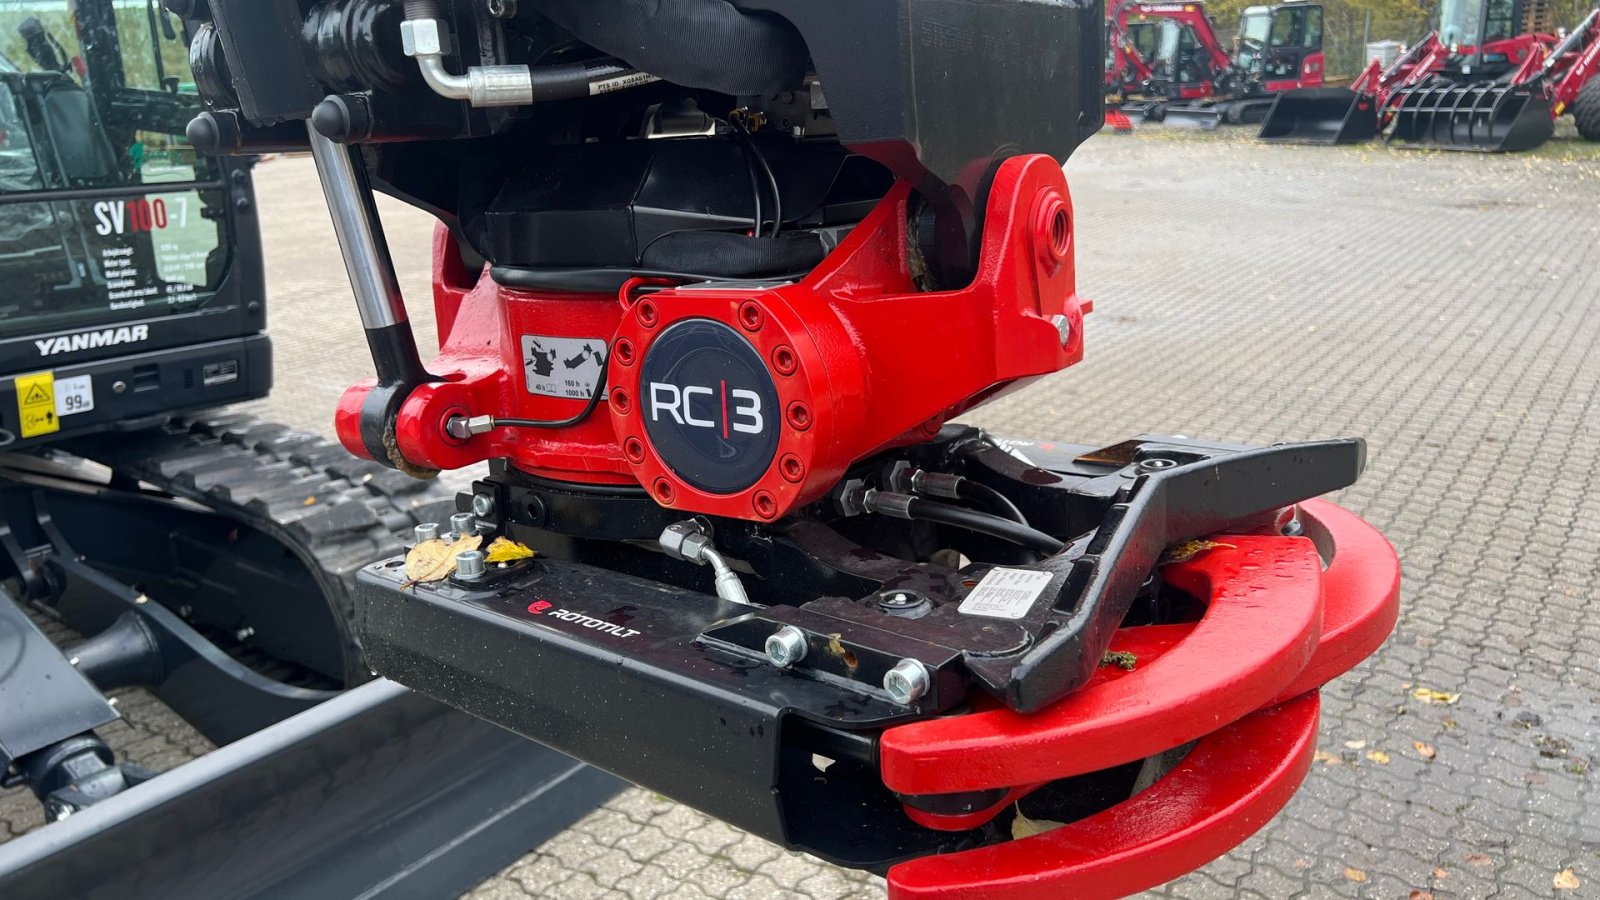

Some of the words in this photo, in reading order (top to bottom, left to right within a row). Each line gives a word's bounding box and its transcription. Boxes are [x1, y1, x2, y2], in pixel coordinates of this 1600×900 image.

[94, 197, 187, 236] SV100-7
[35, 324, 149, 356] YANMAR
[65, 394, 82, 411] 99
[548, 608, 642, 638] ROTOTILT
